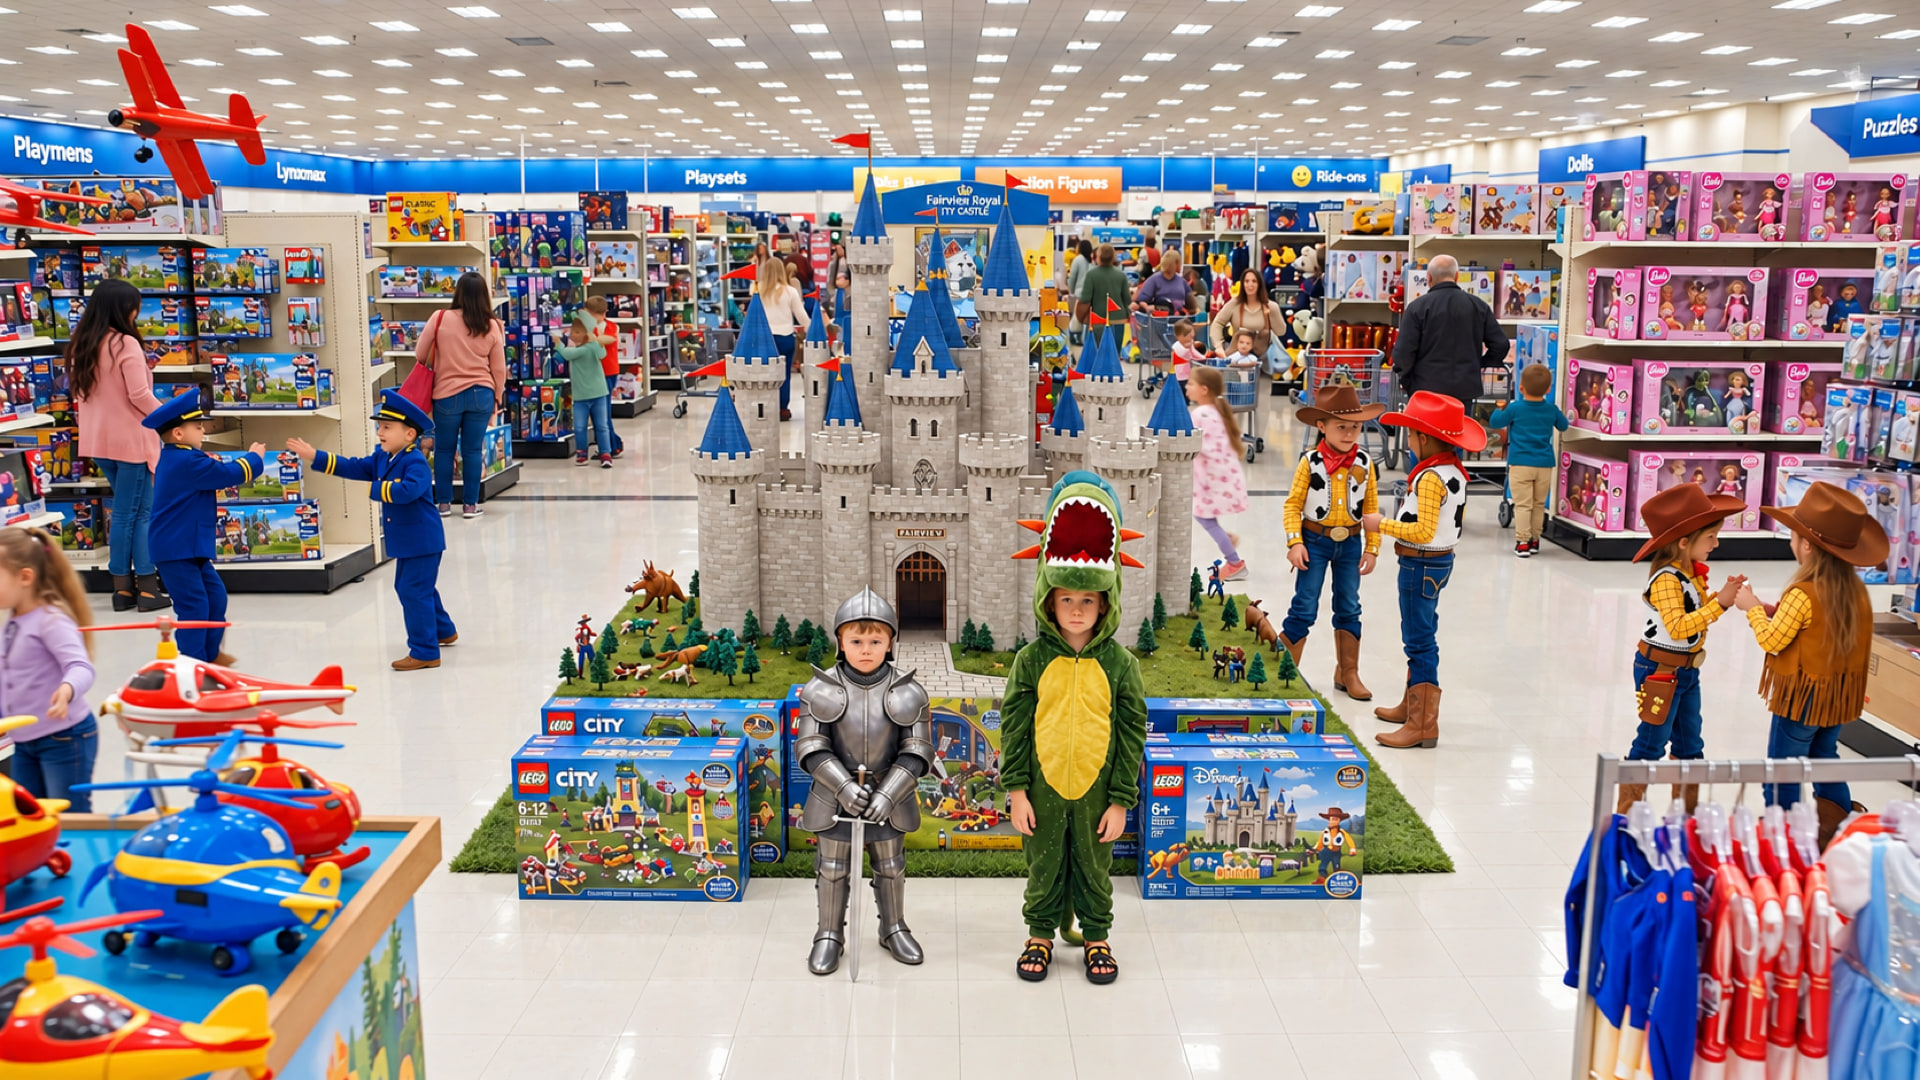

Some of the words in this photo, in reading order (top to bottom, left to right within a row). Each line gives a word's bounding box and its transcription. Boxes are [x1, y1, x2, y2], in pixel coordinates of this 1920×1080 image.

[1863, 113, 1919, 140] Puzzles
[13, 134, 94, 166] Playmens
[1567, 153, 1595, 173] Dolls
[685, 168, 748, 189] Playsets
[1316, 169, 1367, 183] Ride-ons
[1057, 175, 1109, 194] Figures
[972, 194, 1001, 208] Royal
[957, 207, 990, 216] CASTLE
[1153, 775, 1184, 788] LEGO
[518, 801, 549, 815] 6-12
[1151, 802, 1171, 816] 6+
